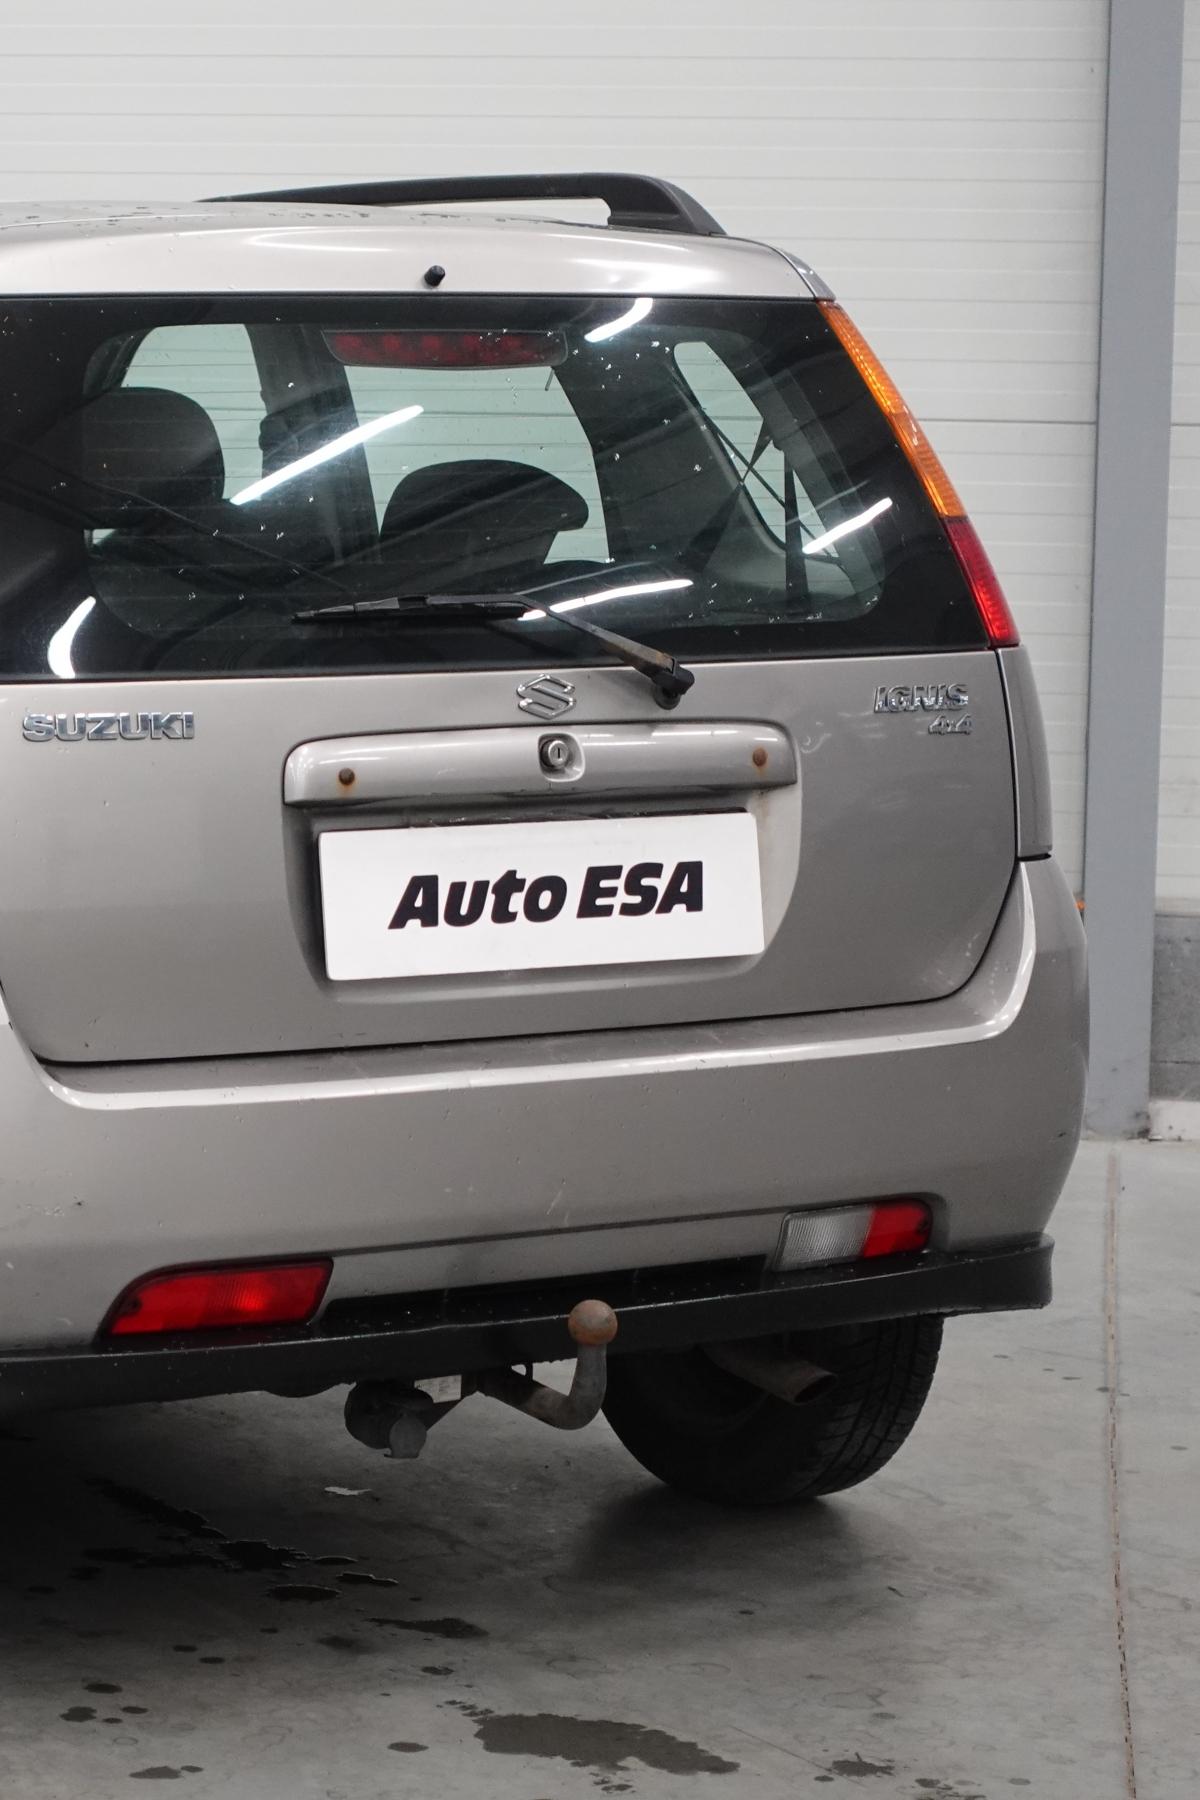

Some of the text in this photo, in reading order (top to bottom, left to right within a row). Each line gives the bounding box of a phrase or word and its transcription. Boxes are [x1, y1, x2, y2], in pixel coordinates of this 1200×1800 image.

[874, 683, 968, 713] IGNIS
[23, 711, 195, 742] SUZUKI
[387, 860, 703, 930] Auto ESA
